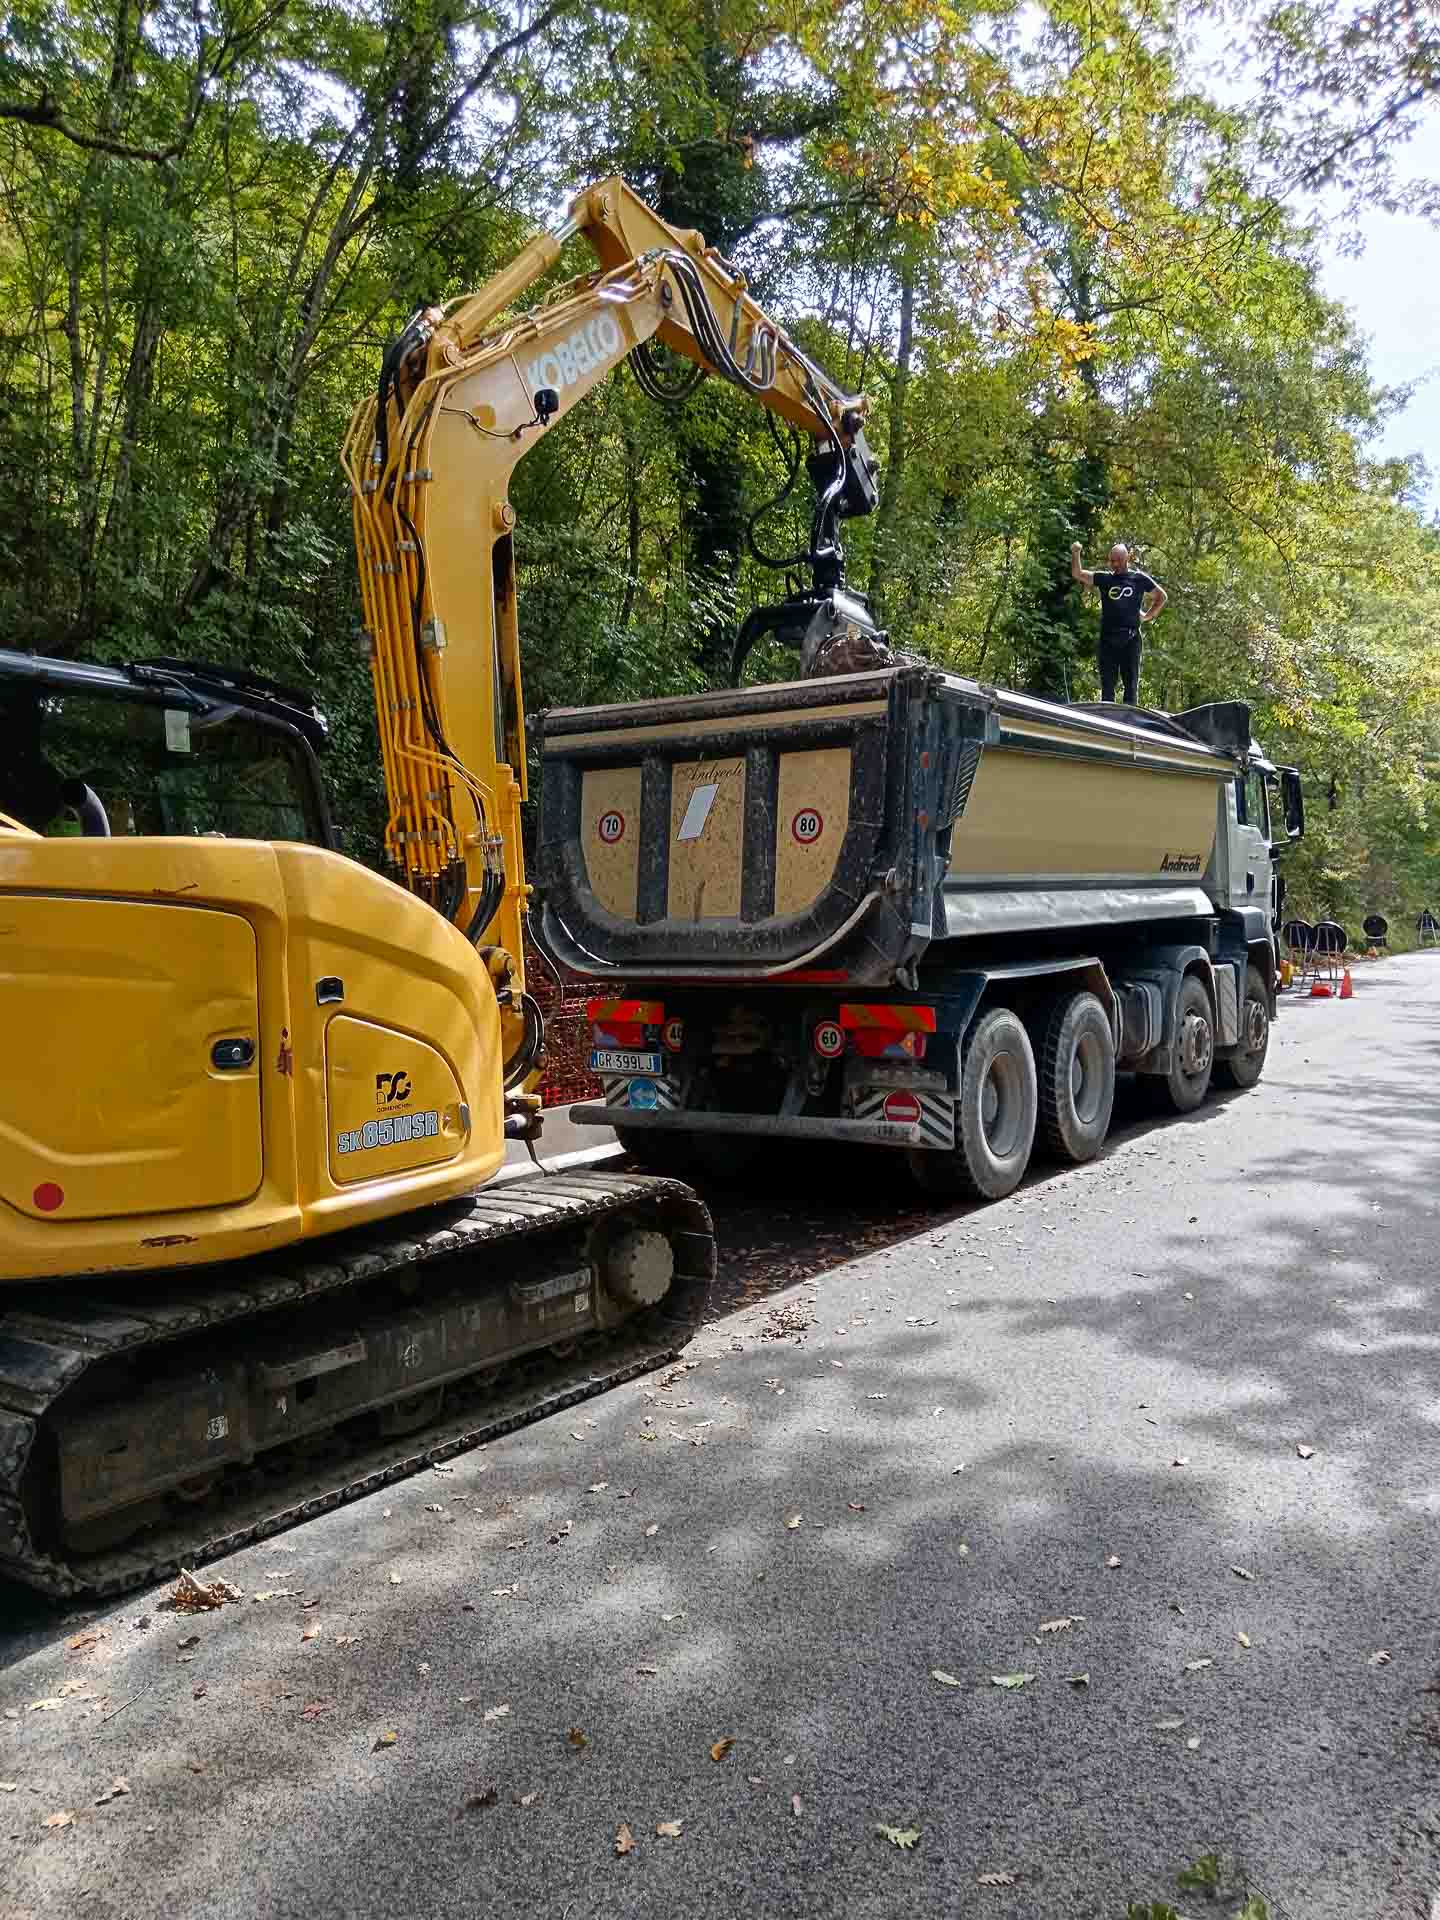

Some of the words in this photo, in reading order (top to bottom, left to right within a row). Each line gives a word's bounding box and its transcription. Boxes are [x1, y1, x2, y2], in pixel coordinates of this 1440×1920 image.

[605, 818, 619, 833] 70
[800, 817, 816, 833] 80
[1159, 852, 1201, 872] Andreoli
[821, 1031, 838, 1045] 60
